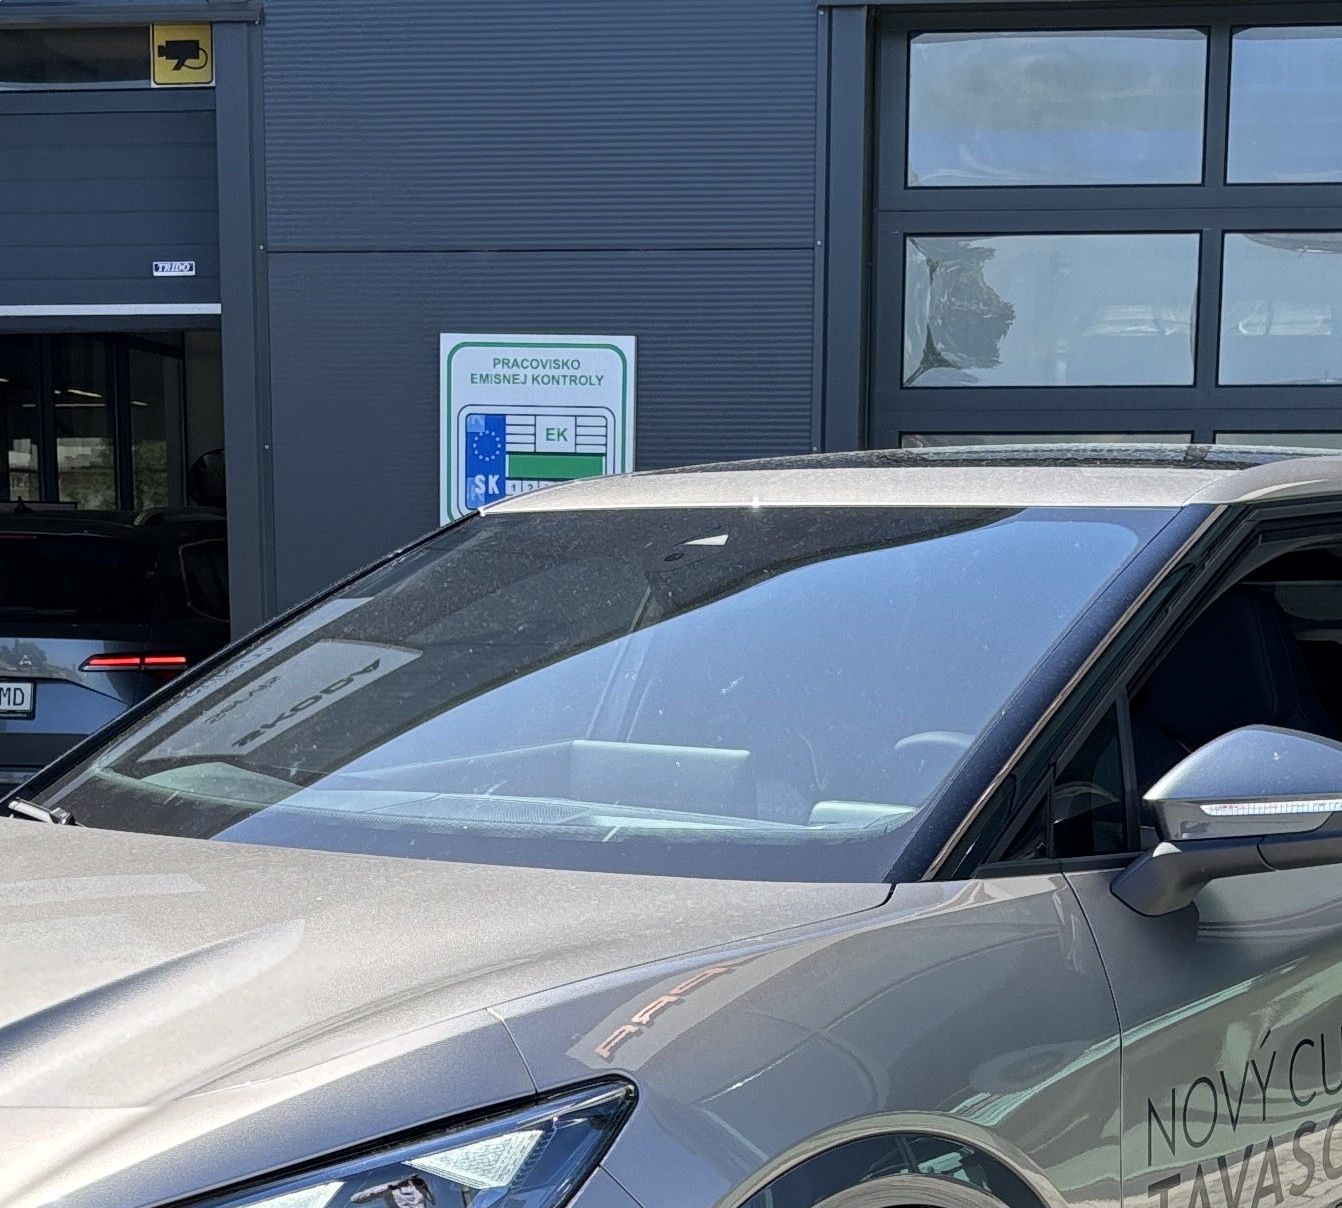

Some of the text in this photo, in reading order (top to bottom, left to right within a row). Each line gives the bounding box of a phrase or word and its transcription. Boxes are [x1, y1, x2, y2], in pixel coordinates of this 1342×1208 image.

[493, 358, 580, 370] PRACOVISKO
[470, 373, 605, 386] EMISNEJ KONTROLY
[545, 428, 568, 441] EK
[474, 474, 499, 494] SK
[1148, 1030, 1277, 1167] NOVÝ
